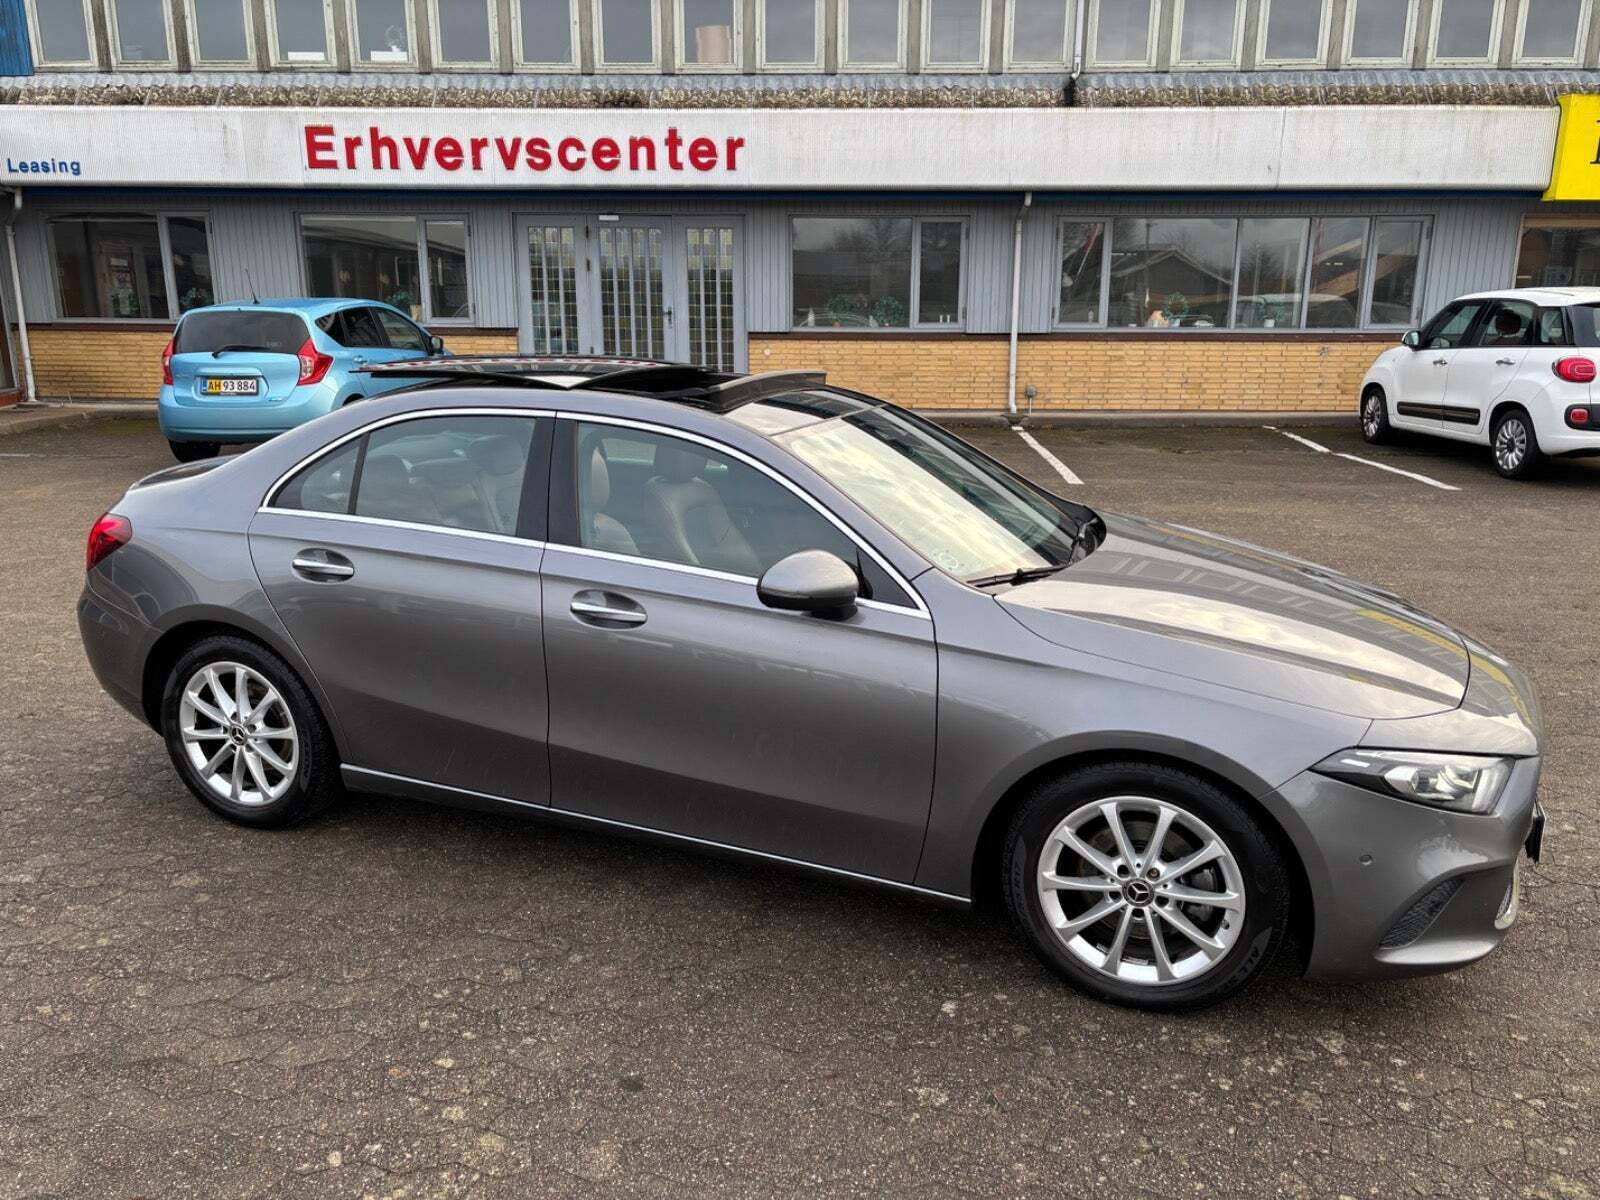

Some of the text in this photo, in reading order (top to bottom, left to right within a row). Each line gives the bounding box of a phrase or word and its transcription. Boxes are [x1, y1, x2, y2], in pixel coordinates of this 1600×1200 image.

[304, 126, 745, 171] Erhvervscenter
[7, 158, 81, 176] Leasing
[208, 381, 256, 391] AH 93 884
